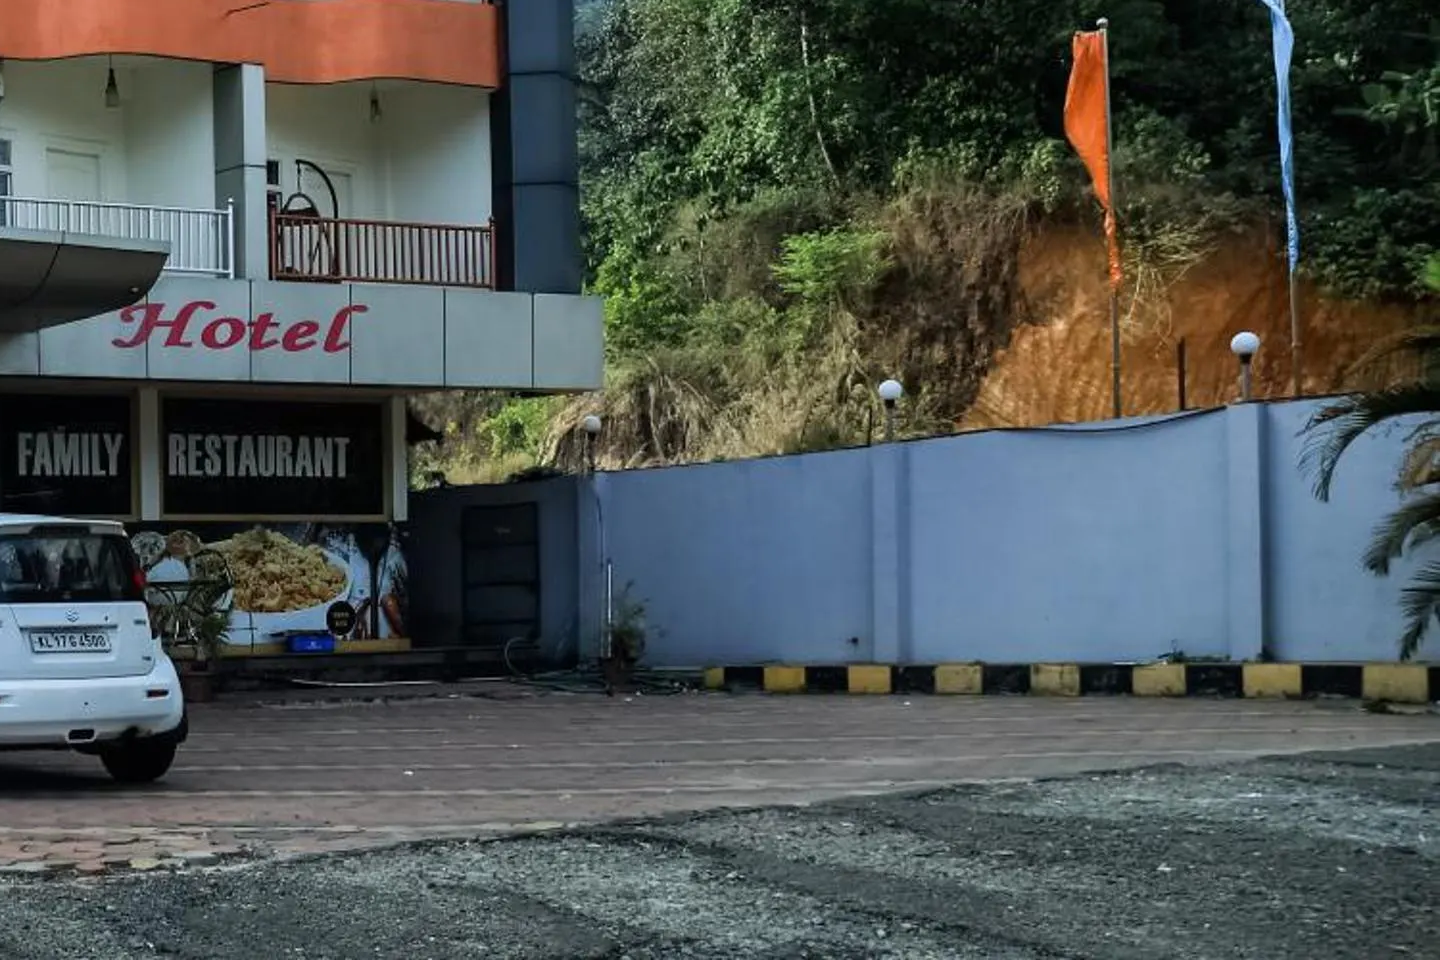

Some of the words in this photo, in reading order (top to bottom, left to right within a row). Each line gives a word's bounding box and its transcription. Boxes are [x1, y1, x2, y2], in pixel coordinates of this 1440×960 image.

[112, 300, 368, 352] Hotel
[17, 431, 125, 478] FAMILY
[167, 432, 350, 479] RESTAURANT
